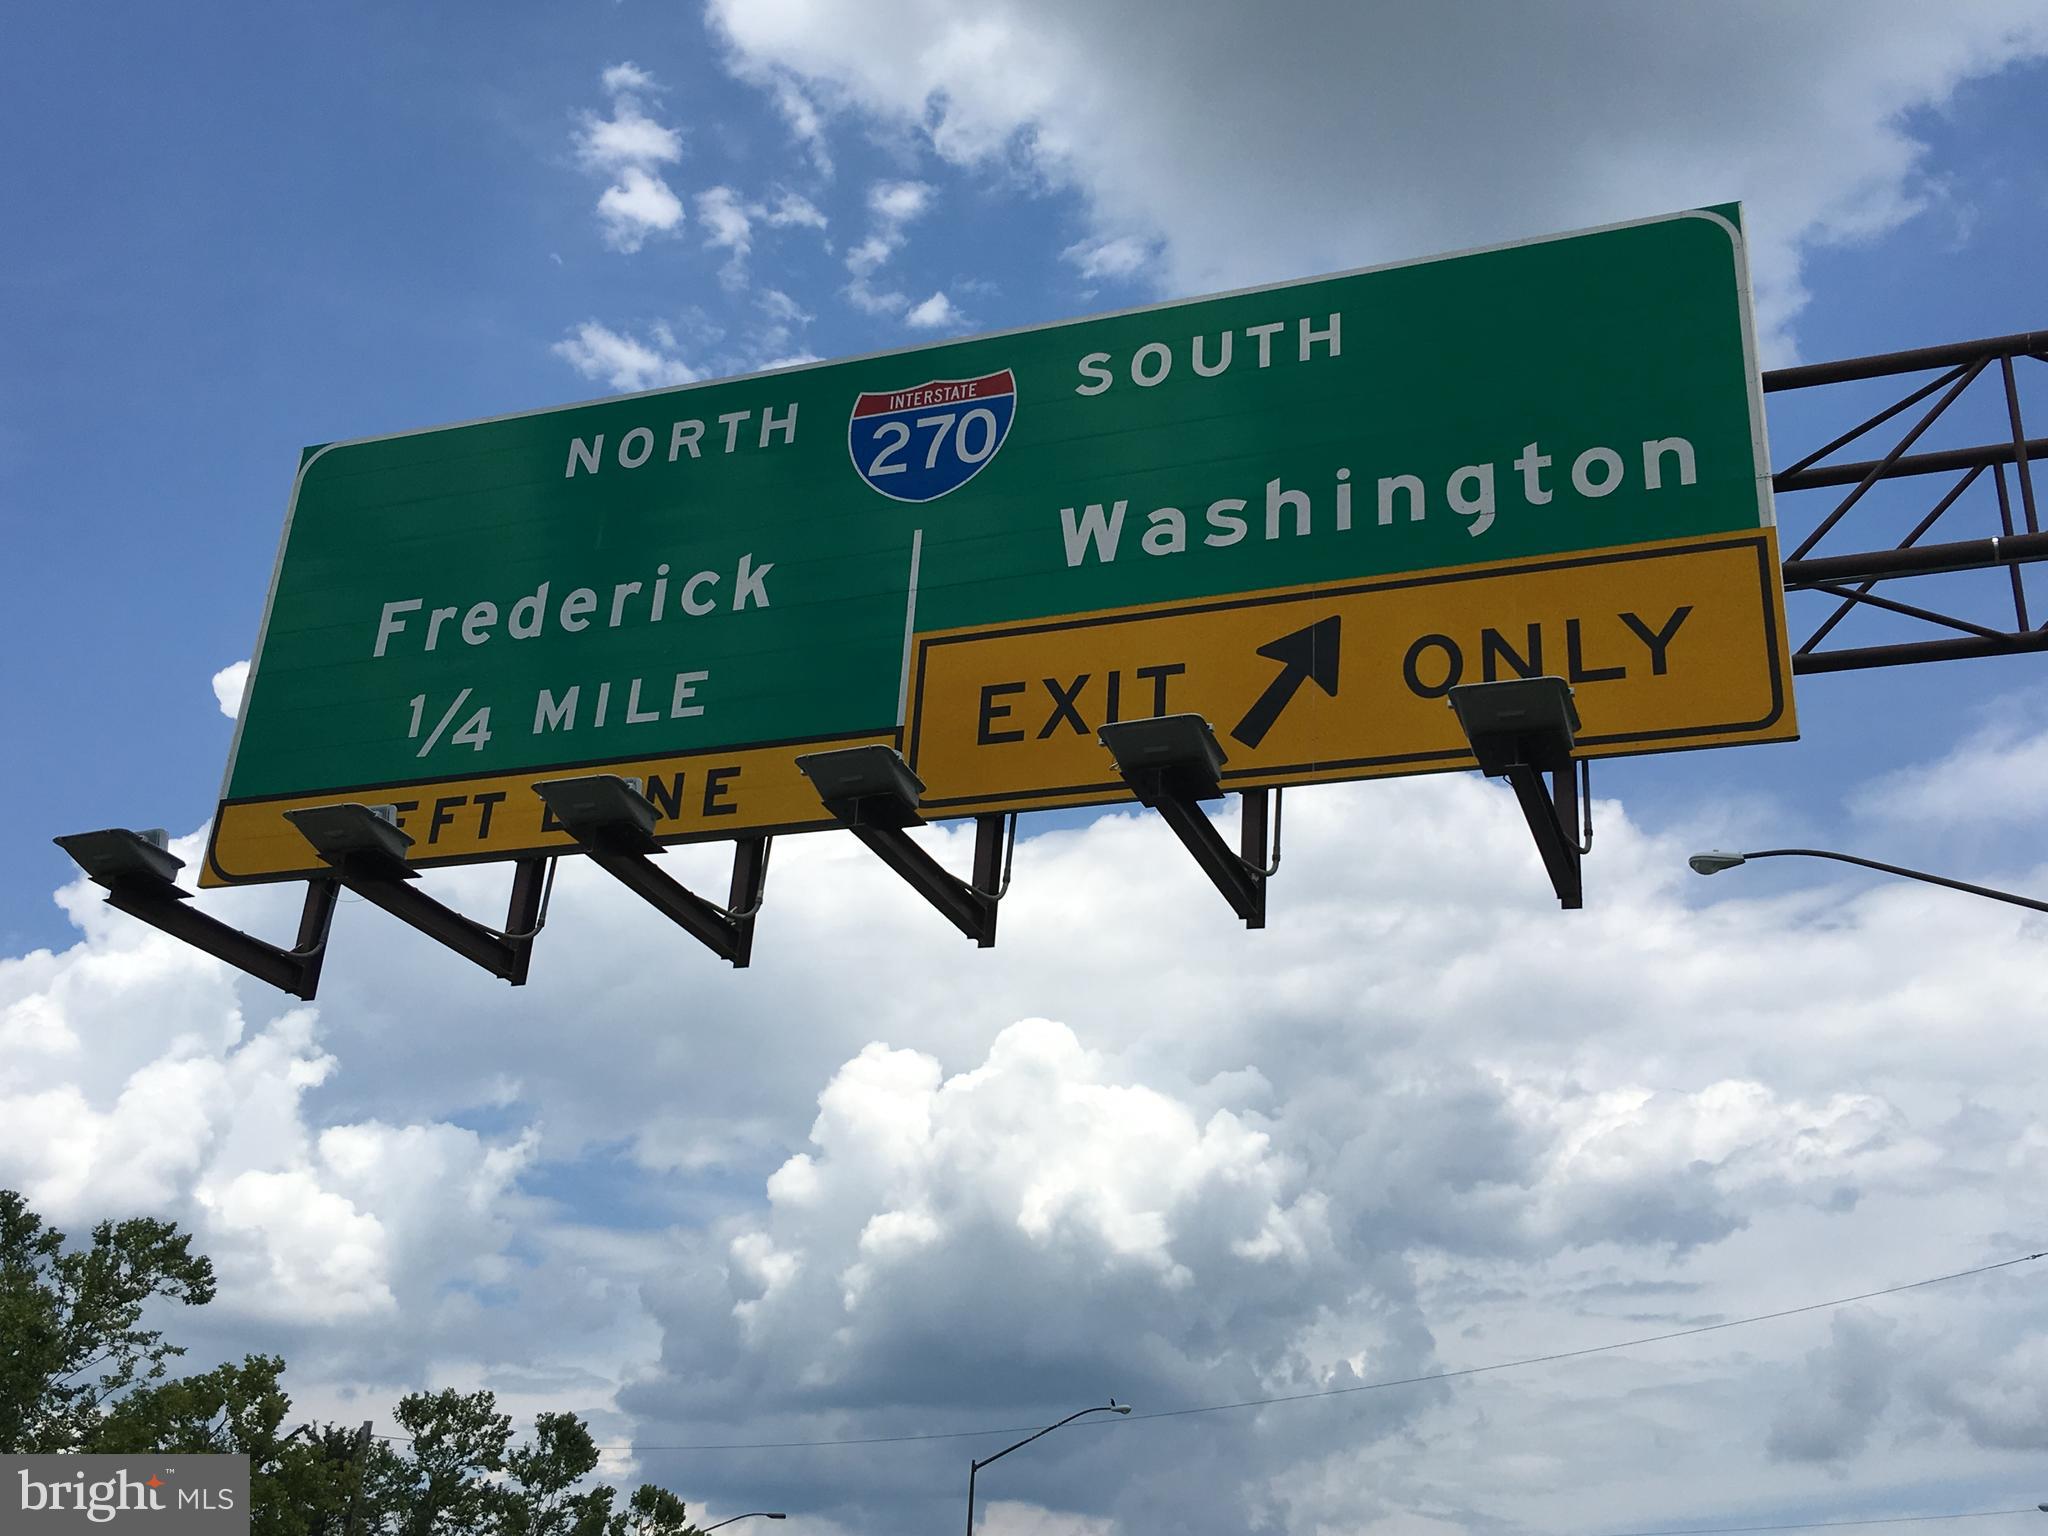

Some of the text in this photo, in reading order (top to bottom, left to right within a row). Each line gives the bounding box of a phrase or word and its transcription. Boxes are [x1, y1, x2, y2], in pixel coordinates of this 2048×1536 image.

[889, 382, 978, 411] INTERSTATE
[1074, 312, 1342, 396] SOUTH
[564, 402, 799, 478] NORTH
[867, 407, 998, 478] 270
[1060, 436, 1698, 567] Washington
[373, 553, 776, 657] Frederick
[408, 670, 710, 757] 1/4 MILE
[976, 605, 1695, 746] EXIT ONLY
